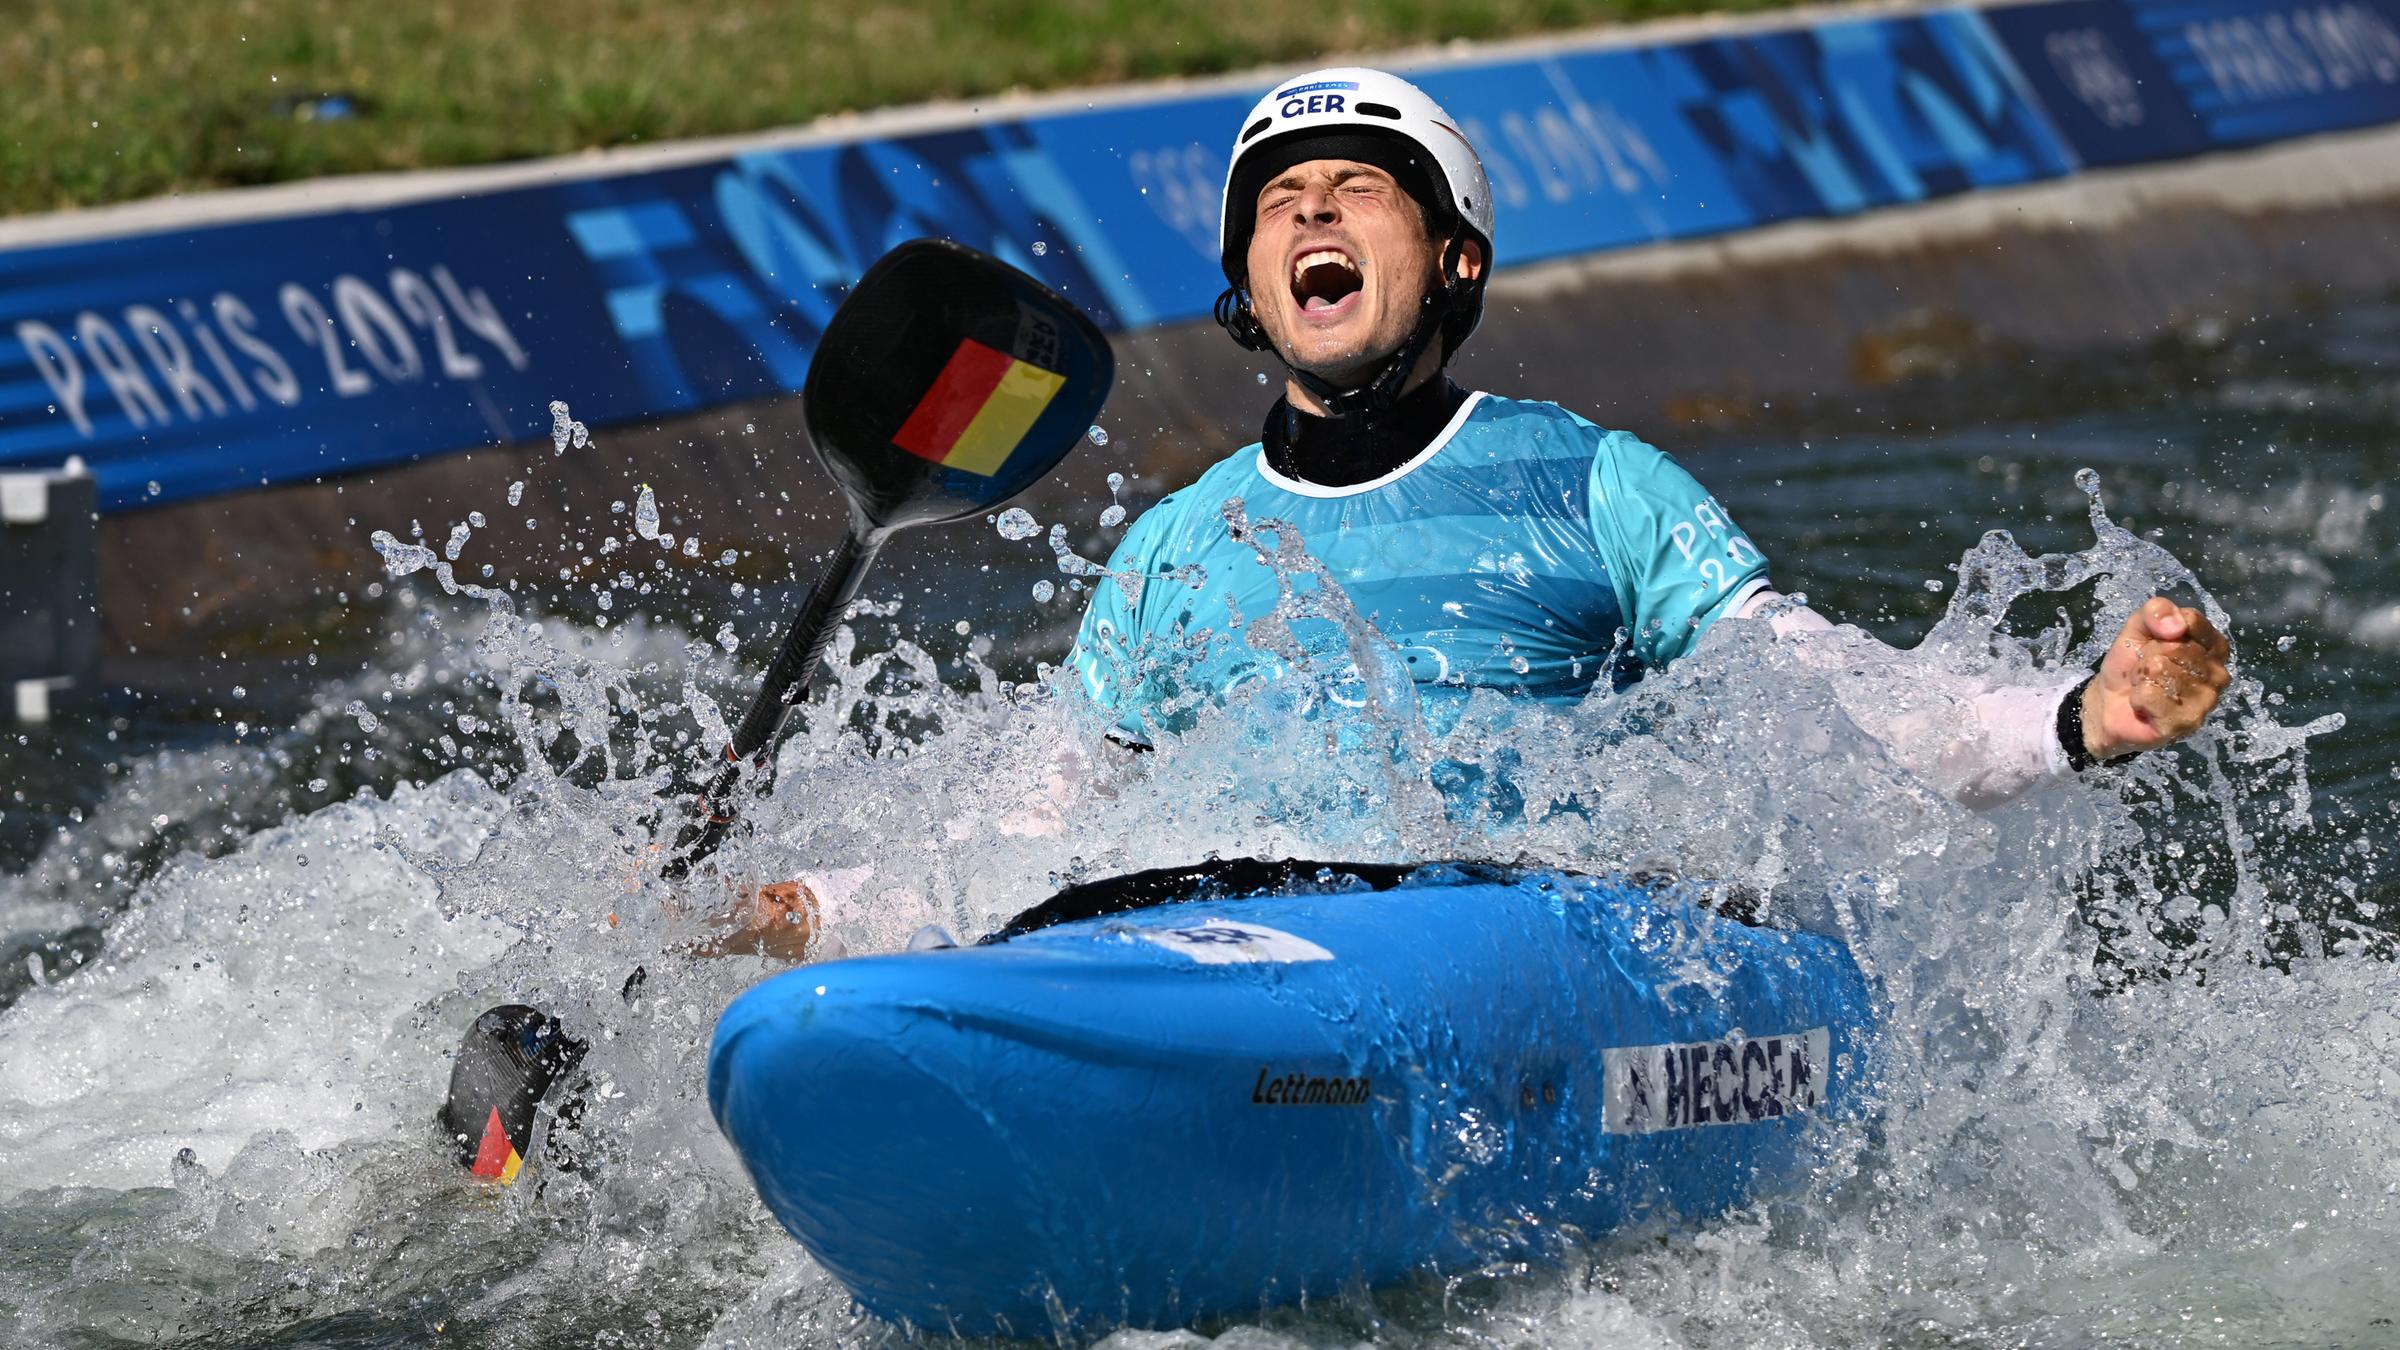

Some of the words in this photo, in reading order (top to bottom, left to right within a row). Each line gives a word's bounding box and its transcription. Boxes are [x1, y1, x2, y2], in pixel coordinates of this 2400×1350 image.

[1281, 94, 1345, 118] GER
[279, 263, 530, 396] 2024
[1670, 495, 1734, 561] PA
